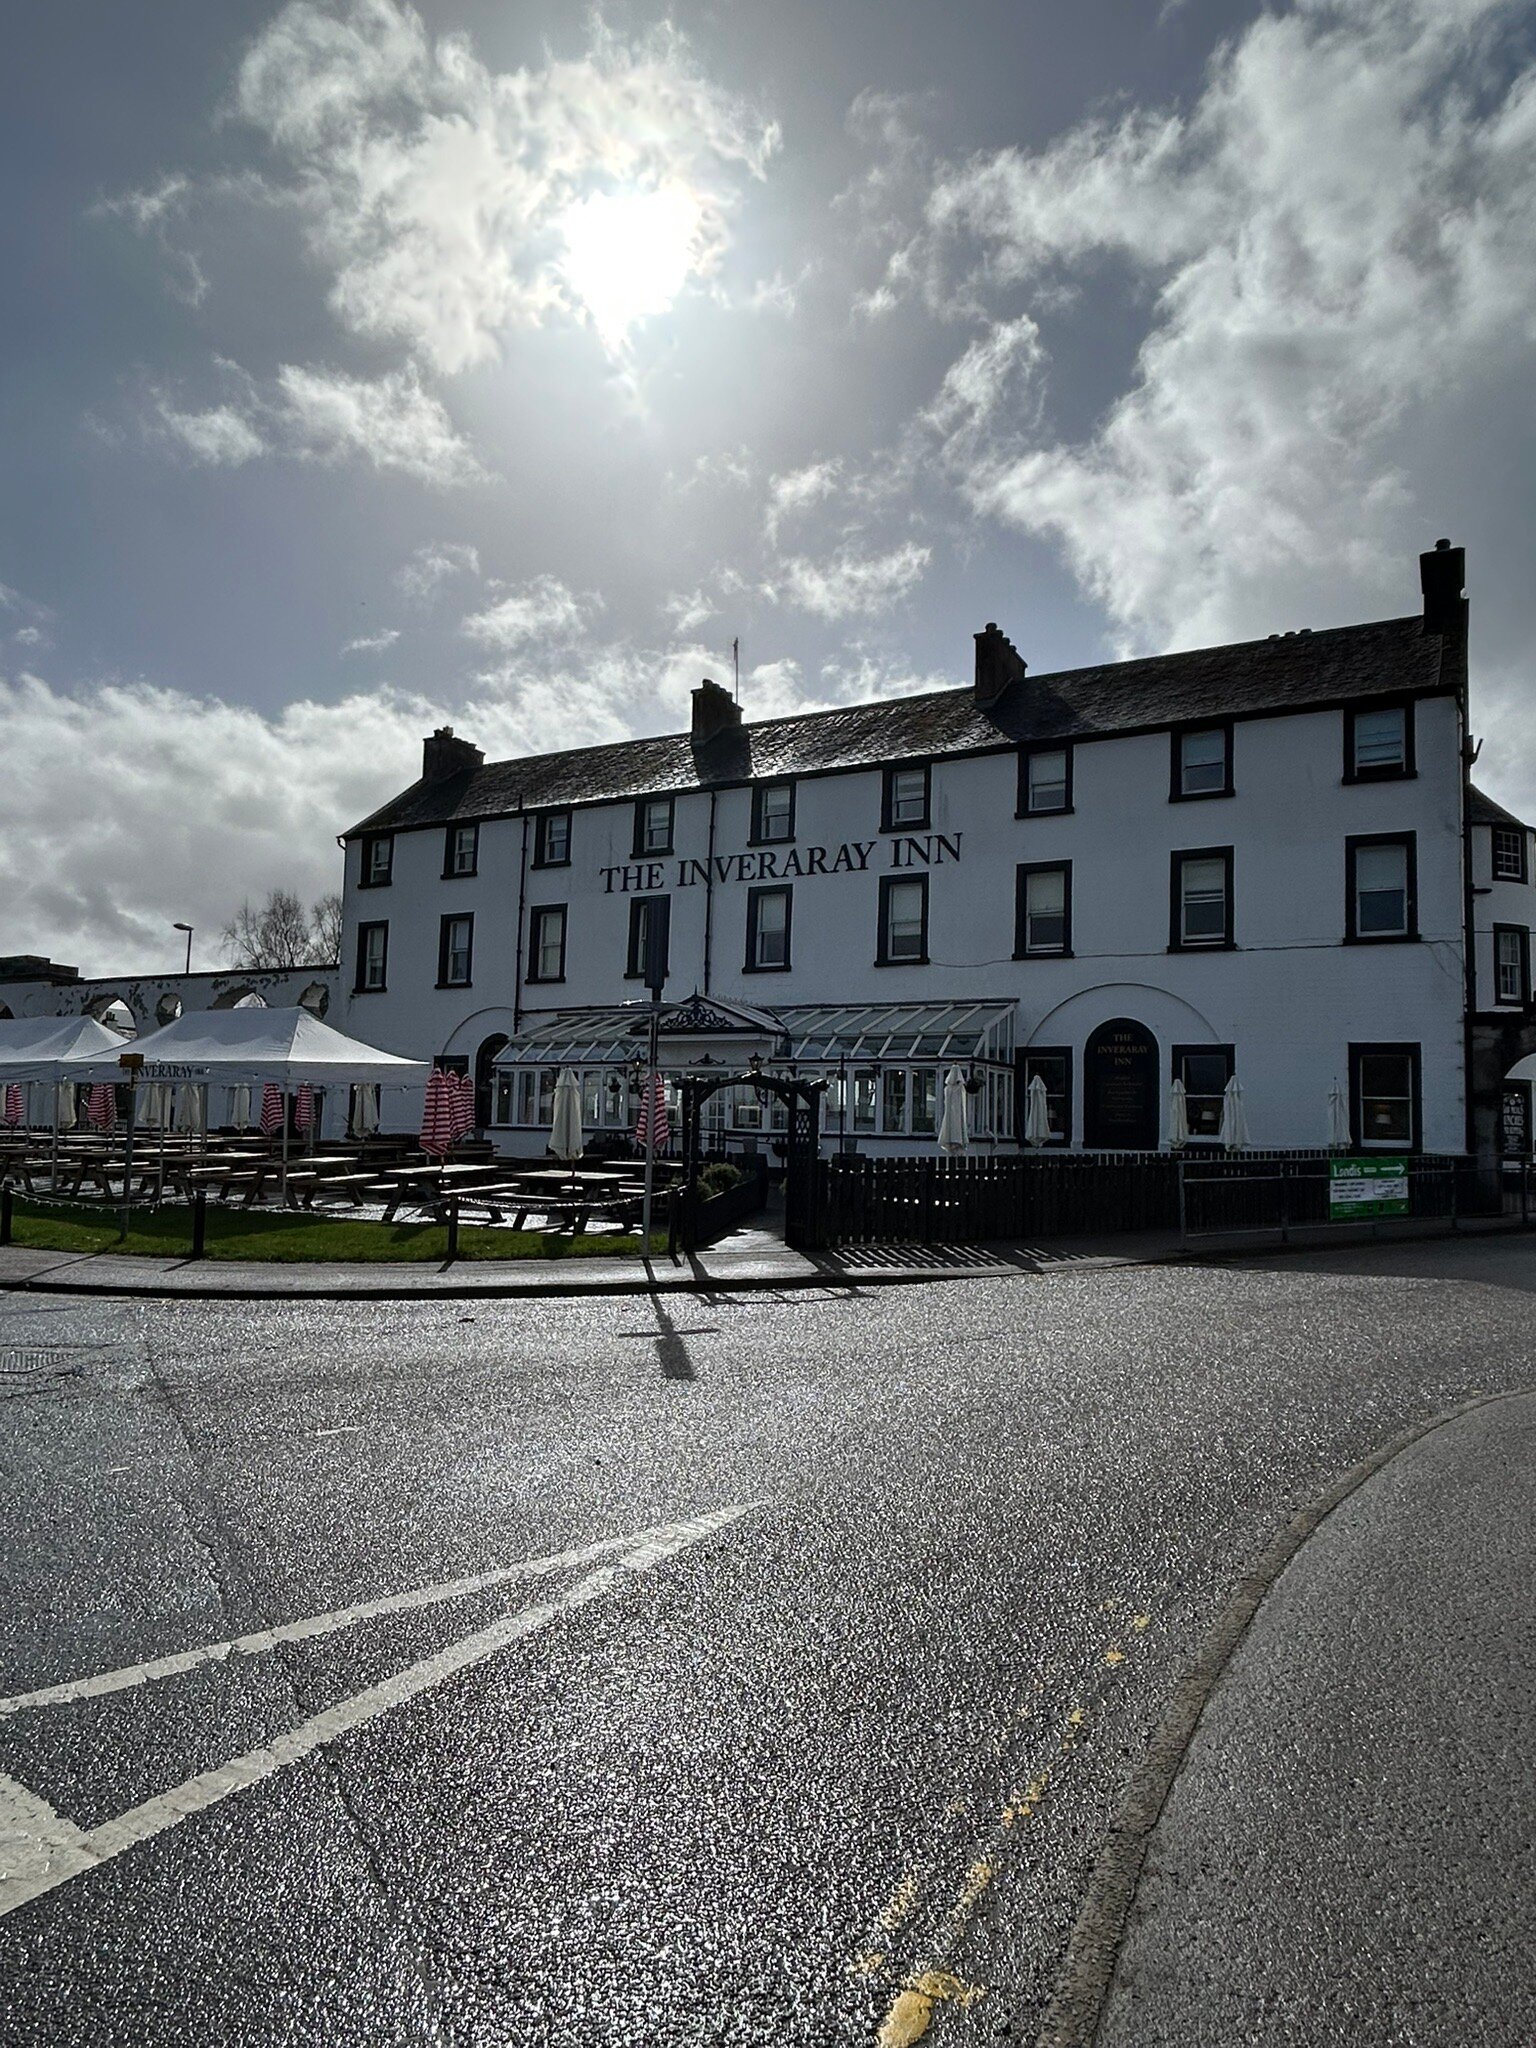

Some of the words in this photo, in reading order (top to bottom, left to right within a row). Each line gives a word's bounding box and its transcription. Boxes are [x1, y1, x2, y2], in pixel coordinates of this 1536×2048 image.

[600, 863, 664, 893] THE
[677, 841, 877, 886] INVERARAY
[891, 832, 963, 868] INN
[1113, 1033, 1132, 1042] THE
[1097, 1045, 1148, 1054] INVERARAY
[1114, 1057, 1132, 1066] INN
